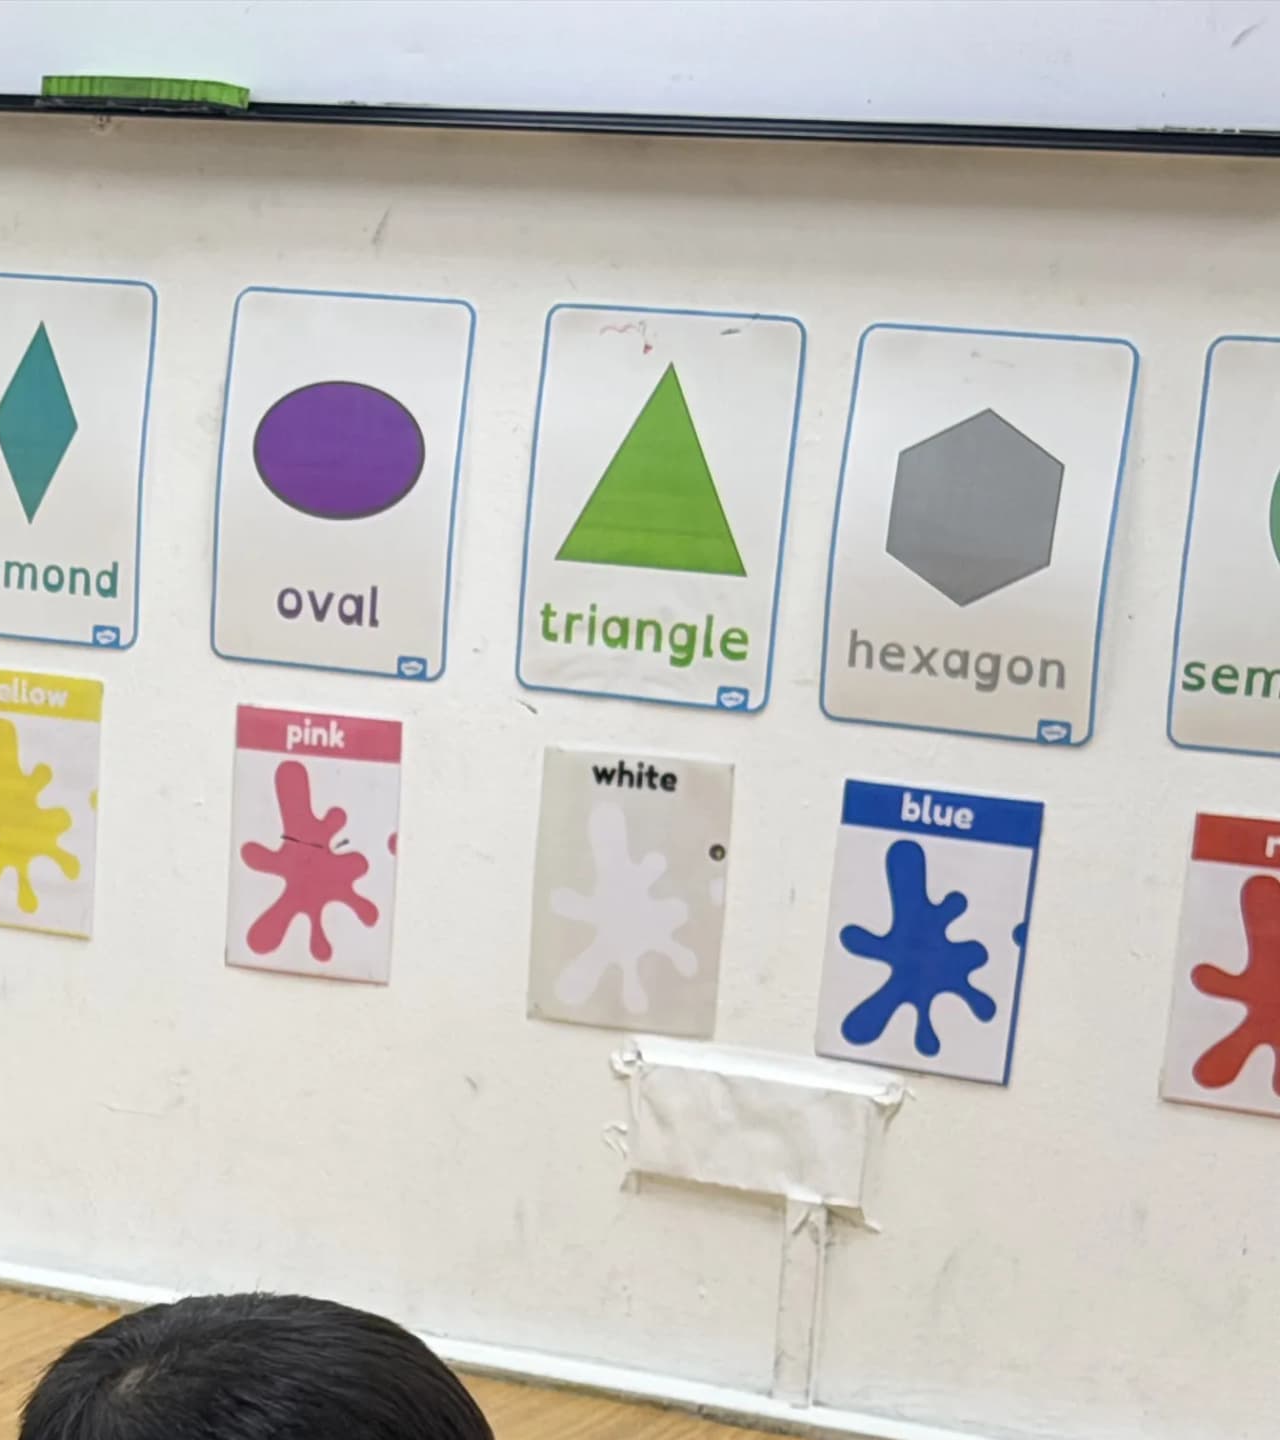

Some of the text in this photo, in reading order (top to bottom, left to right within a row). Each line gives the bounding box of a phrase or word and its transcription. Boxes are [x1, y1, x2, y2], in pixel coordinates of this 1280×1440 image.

[277, 585, 380, 628] oval
[540, 602, 750, 668] triangle
[847, 629, 1067, 693] hexagon
[285, 720, 345, 750] pink
[592, 760, 678, 792] white
[900, 791, 974, 831] blue
